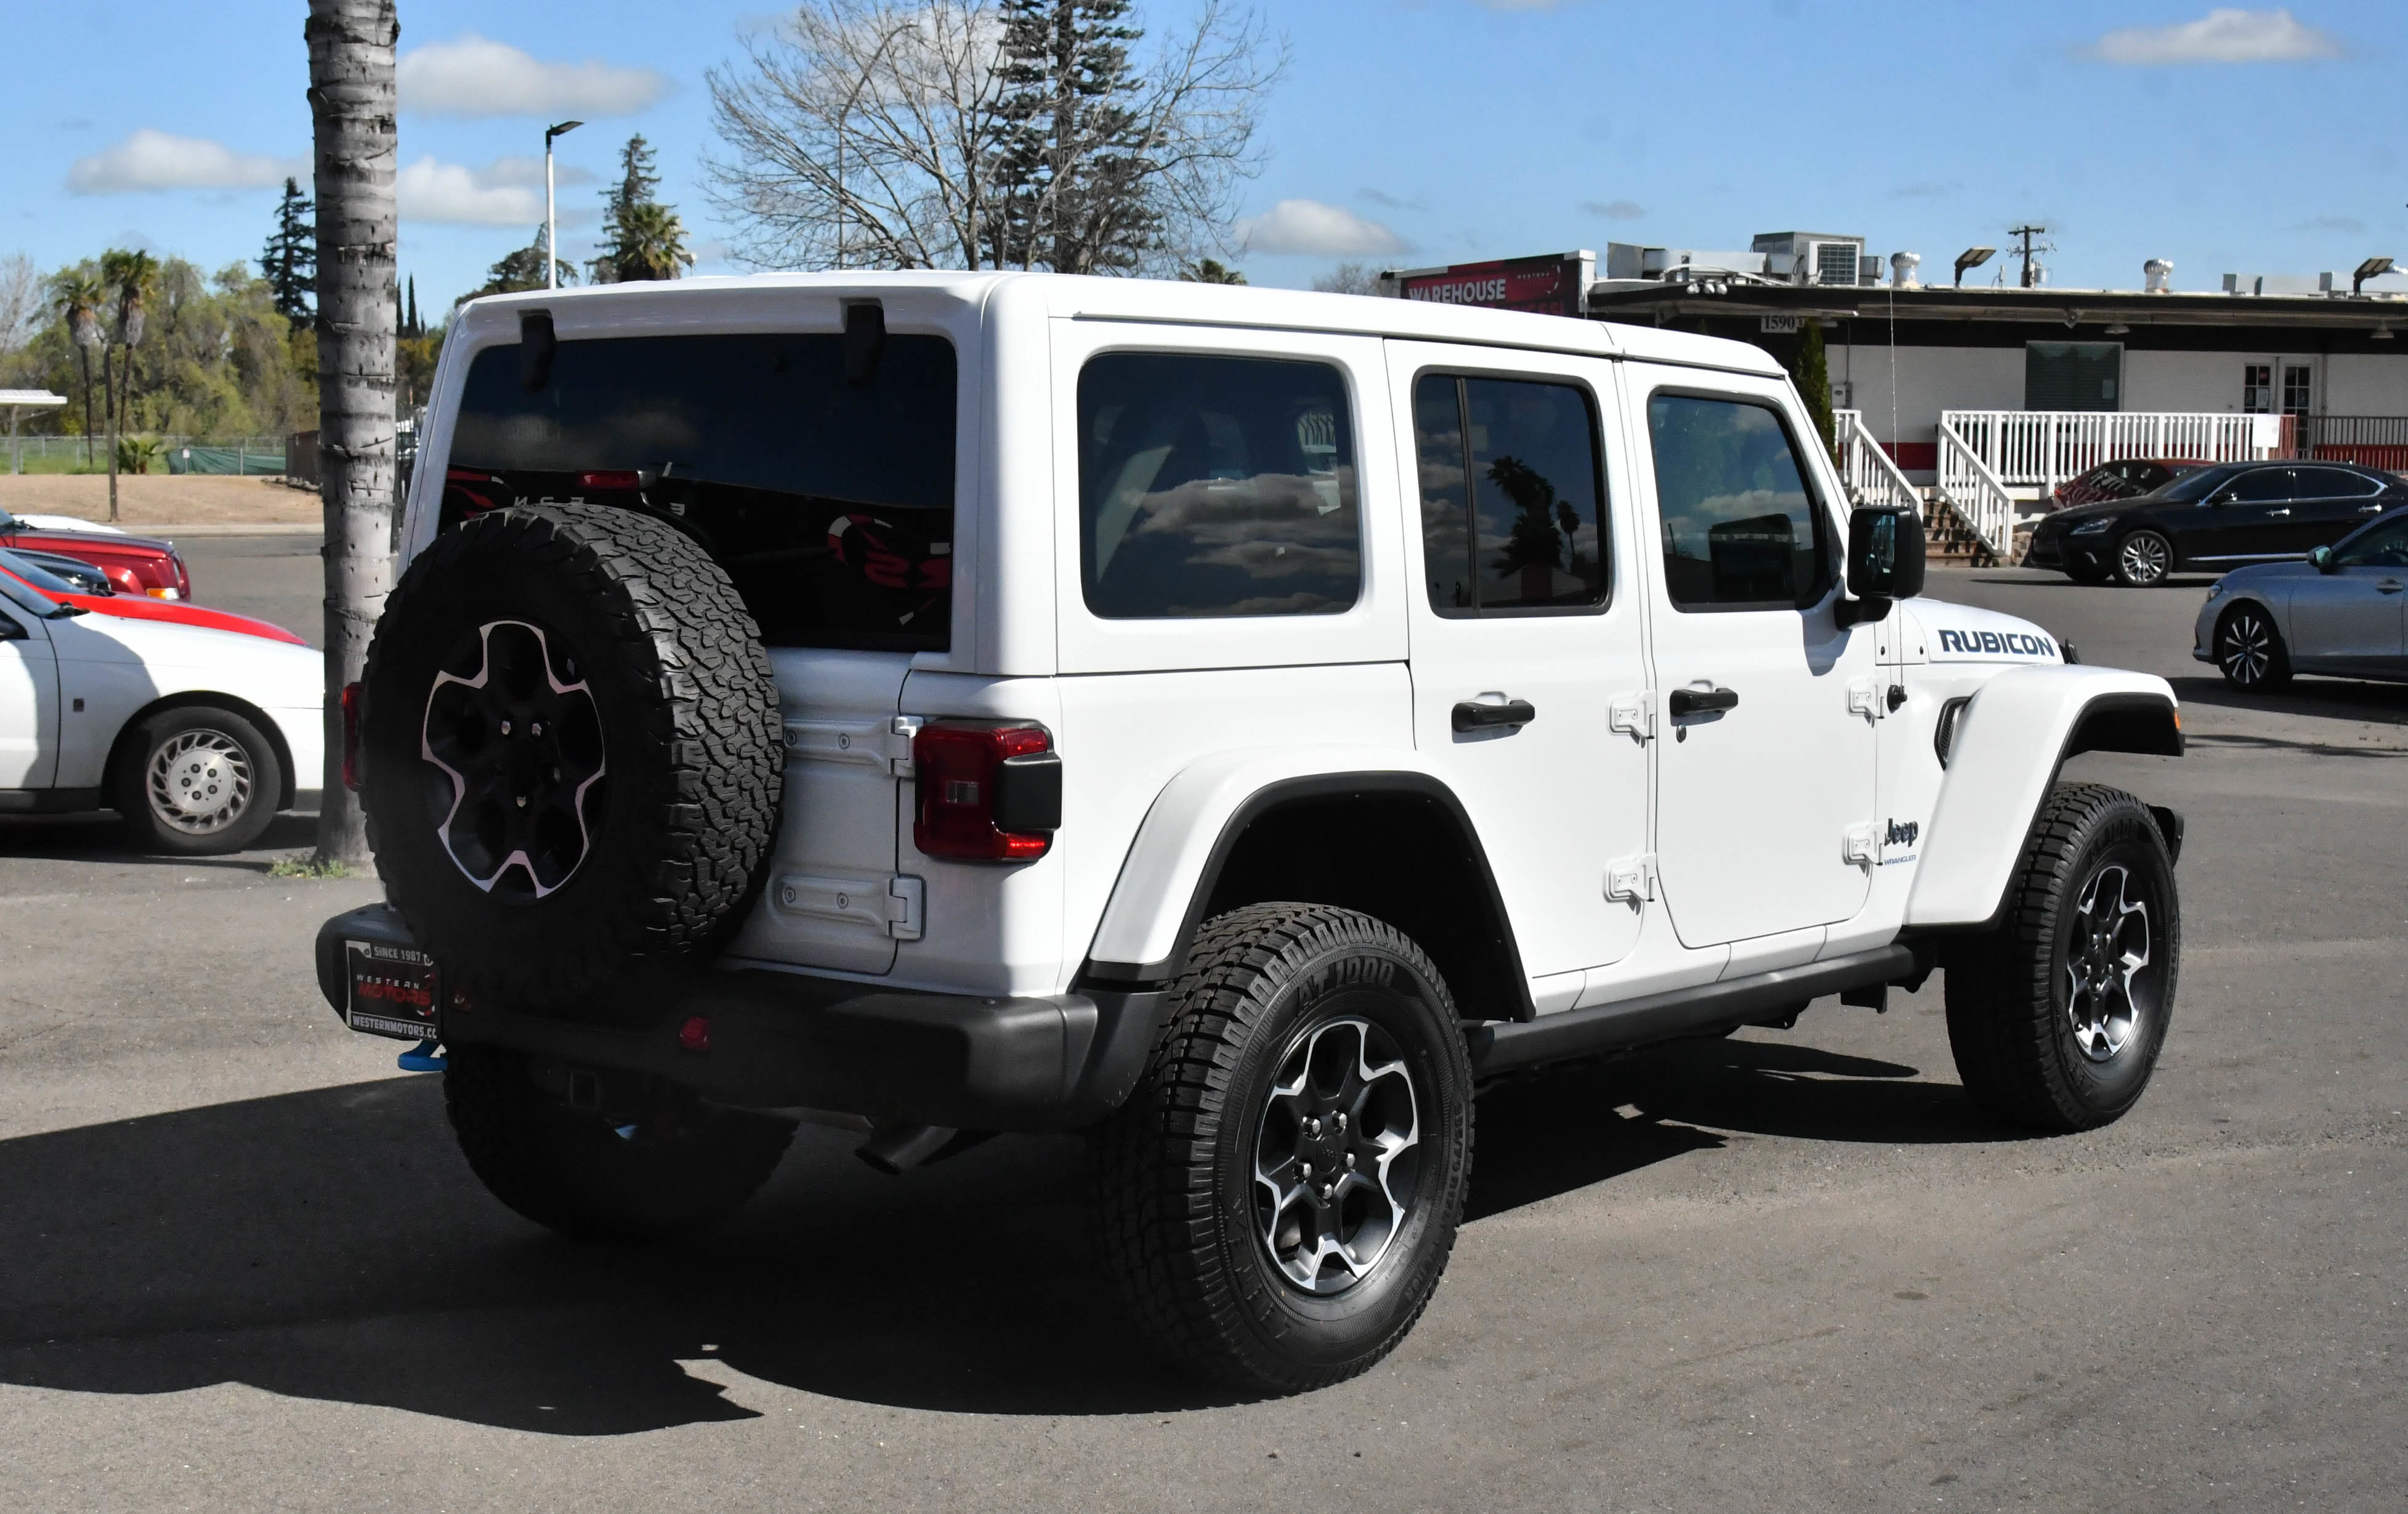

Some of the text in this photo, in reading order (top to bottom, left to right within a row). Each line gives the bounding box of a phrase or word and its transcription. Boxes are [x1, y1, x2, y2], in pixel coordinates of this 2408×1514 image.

[1408, 279, 1506, 304] WAREHOUSE
[1764, 315, 1795, 329] 1590
[1937, 629, 2055, 657] RUBICON
[1884, 818, 1918, 848] Jeep
[1884, 855, 1917, 866] WRANGLER
[374, 945, 421, 962] SINCE 1987
[357, 974, 419, 989] WESTERN
[358, 981, 432, 1006] MOTORS
